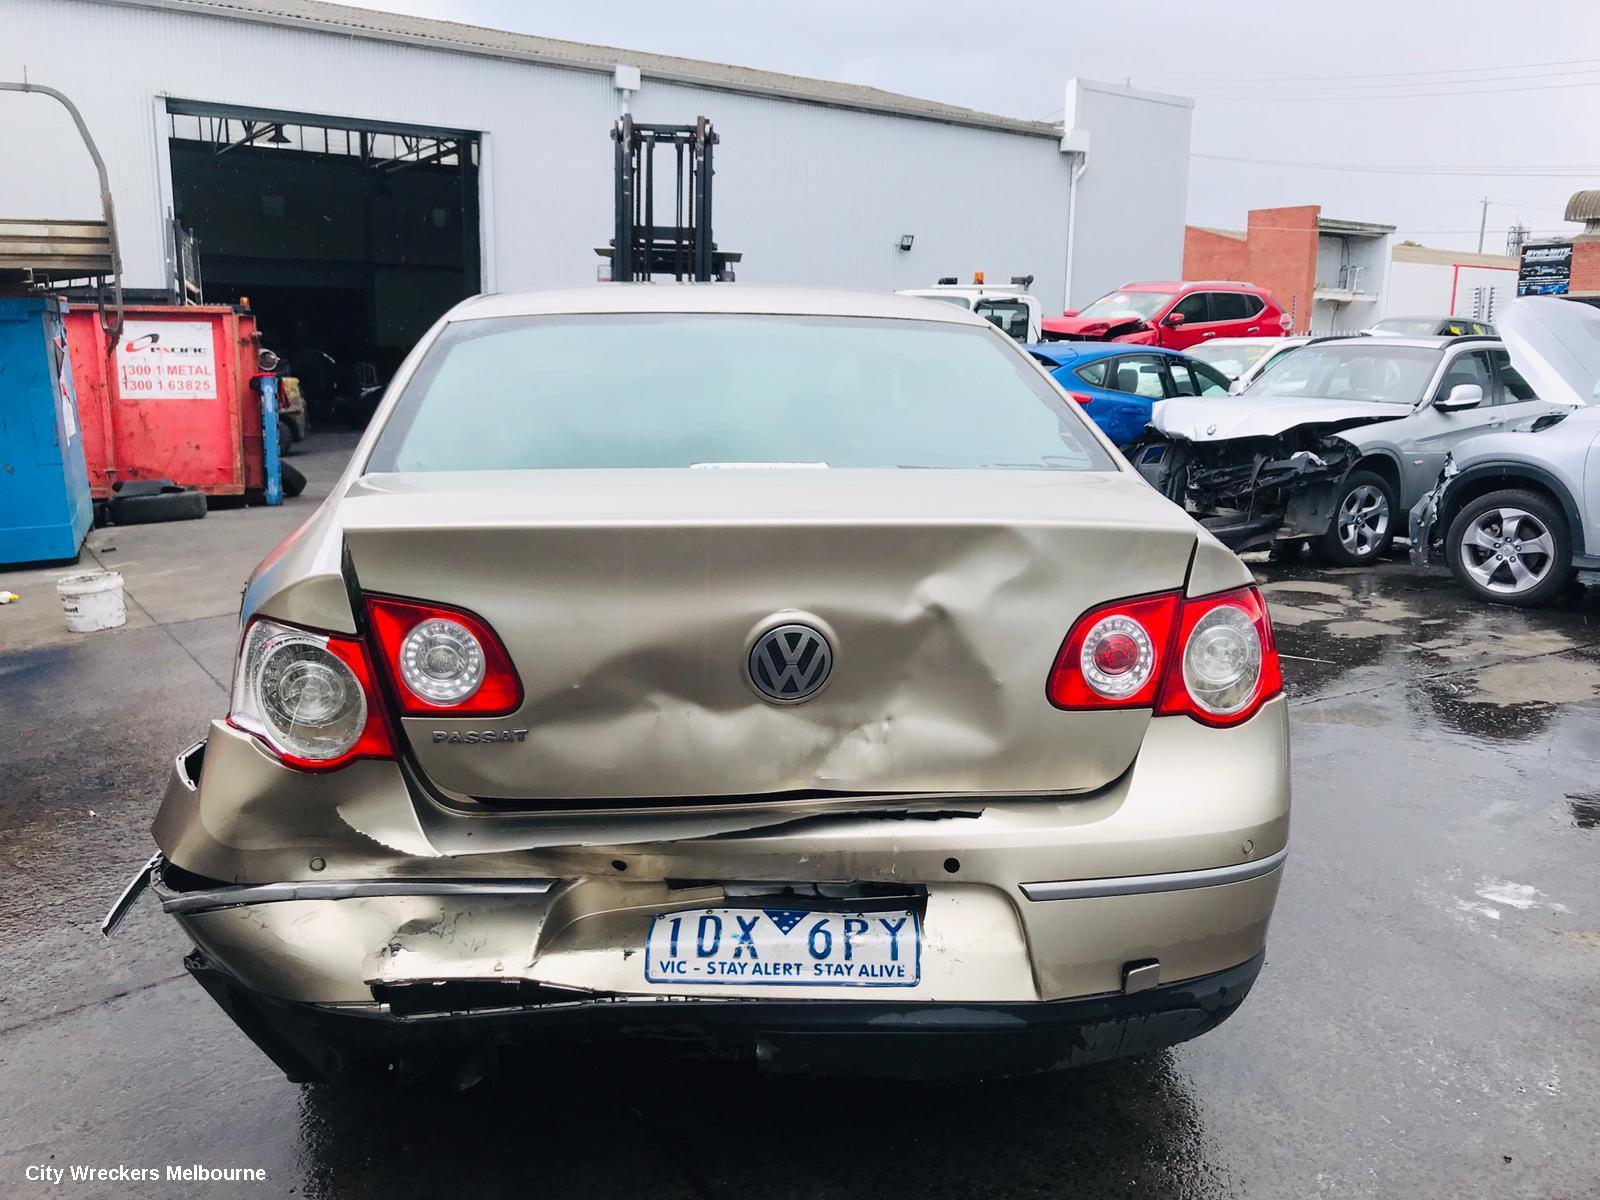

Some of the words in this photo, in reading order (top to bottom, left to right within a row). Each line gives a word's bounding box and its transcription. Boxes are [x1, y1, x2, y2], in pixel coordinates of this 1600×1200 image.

[121, 365, 151, 376] 1300
[167, 365, 212, 376] METAL
[123, 380, 152, 391] 1300
[168, 380, 211, 391] 63825
[432, 729, 529, 744] PASSAT
[668, 914, 761, 960] 1DX
[807, 917, 907, 961] 6PY
[659, 960, 687, 974] VIC
[707, 961, 749, 976] STAY
[751, 962, 803, 976] ALERT
[813, 963, 854, 977] STAY
[858, 964, 905, 978] ALIVE
